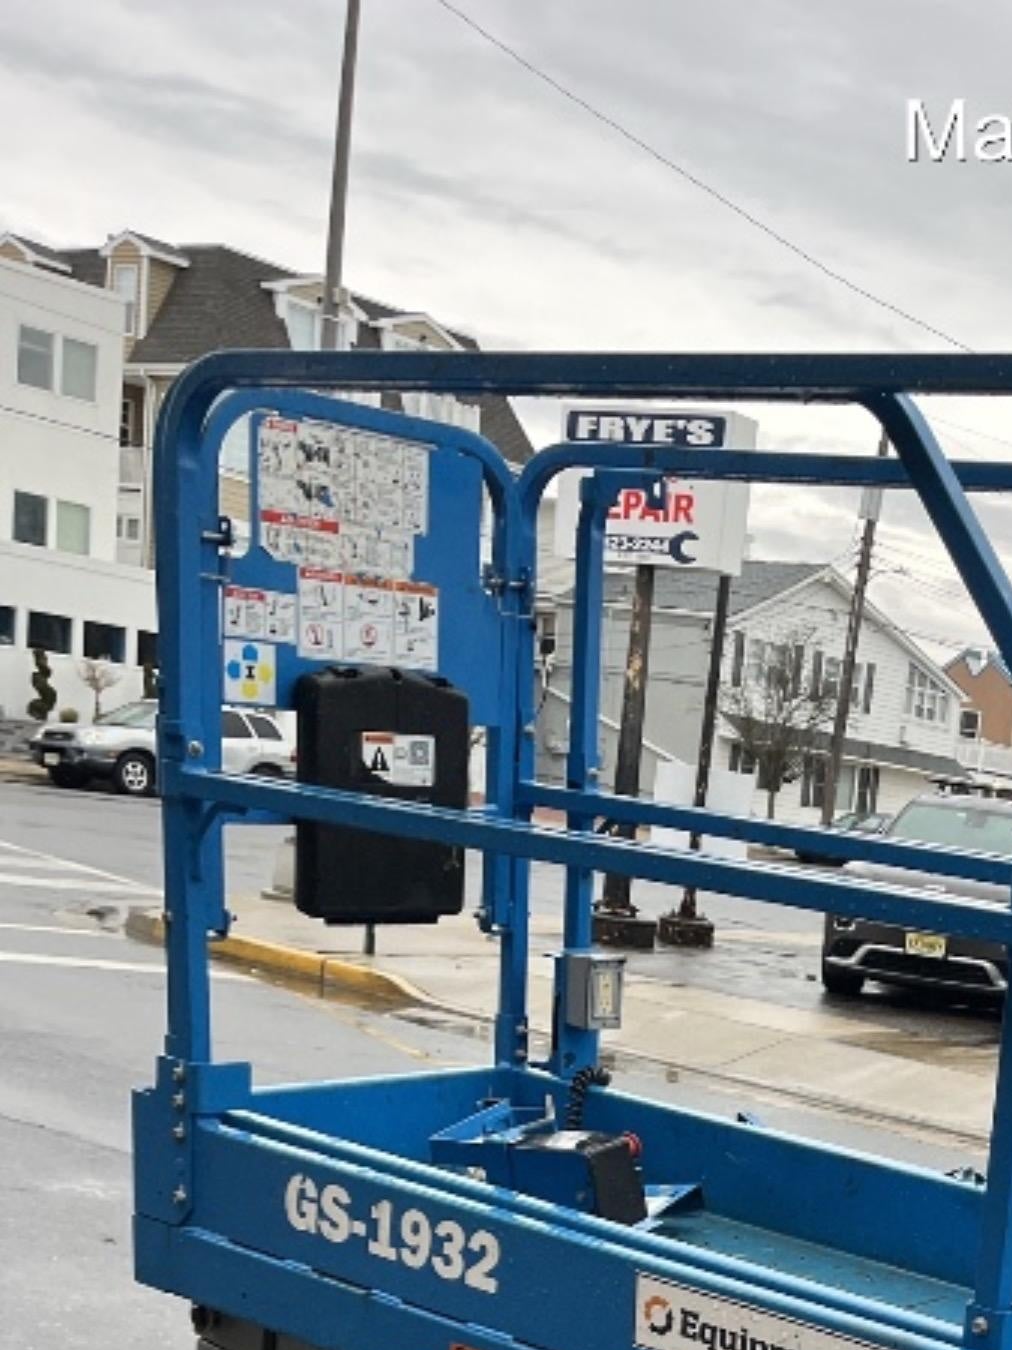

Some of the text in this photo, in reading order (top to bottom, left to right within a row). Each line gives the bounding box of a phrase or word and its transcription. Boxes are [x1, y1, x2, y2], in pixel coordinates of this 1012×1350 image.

[575, 415, 715, 445] FRYE'S
[607, 488, 694, 524] PAIR
[284, 1173, 500, 1295] GS-1932
